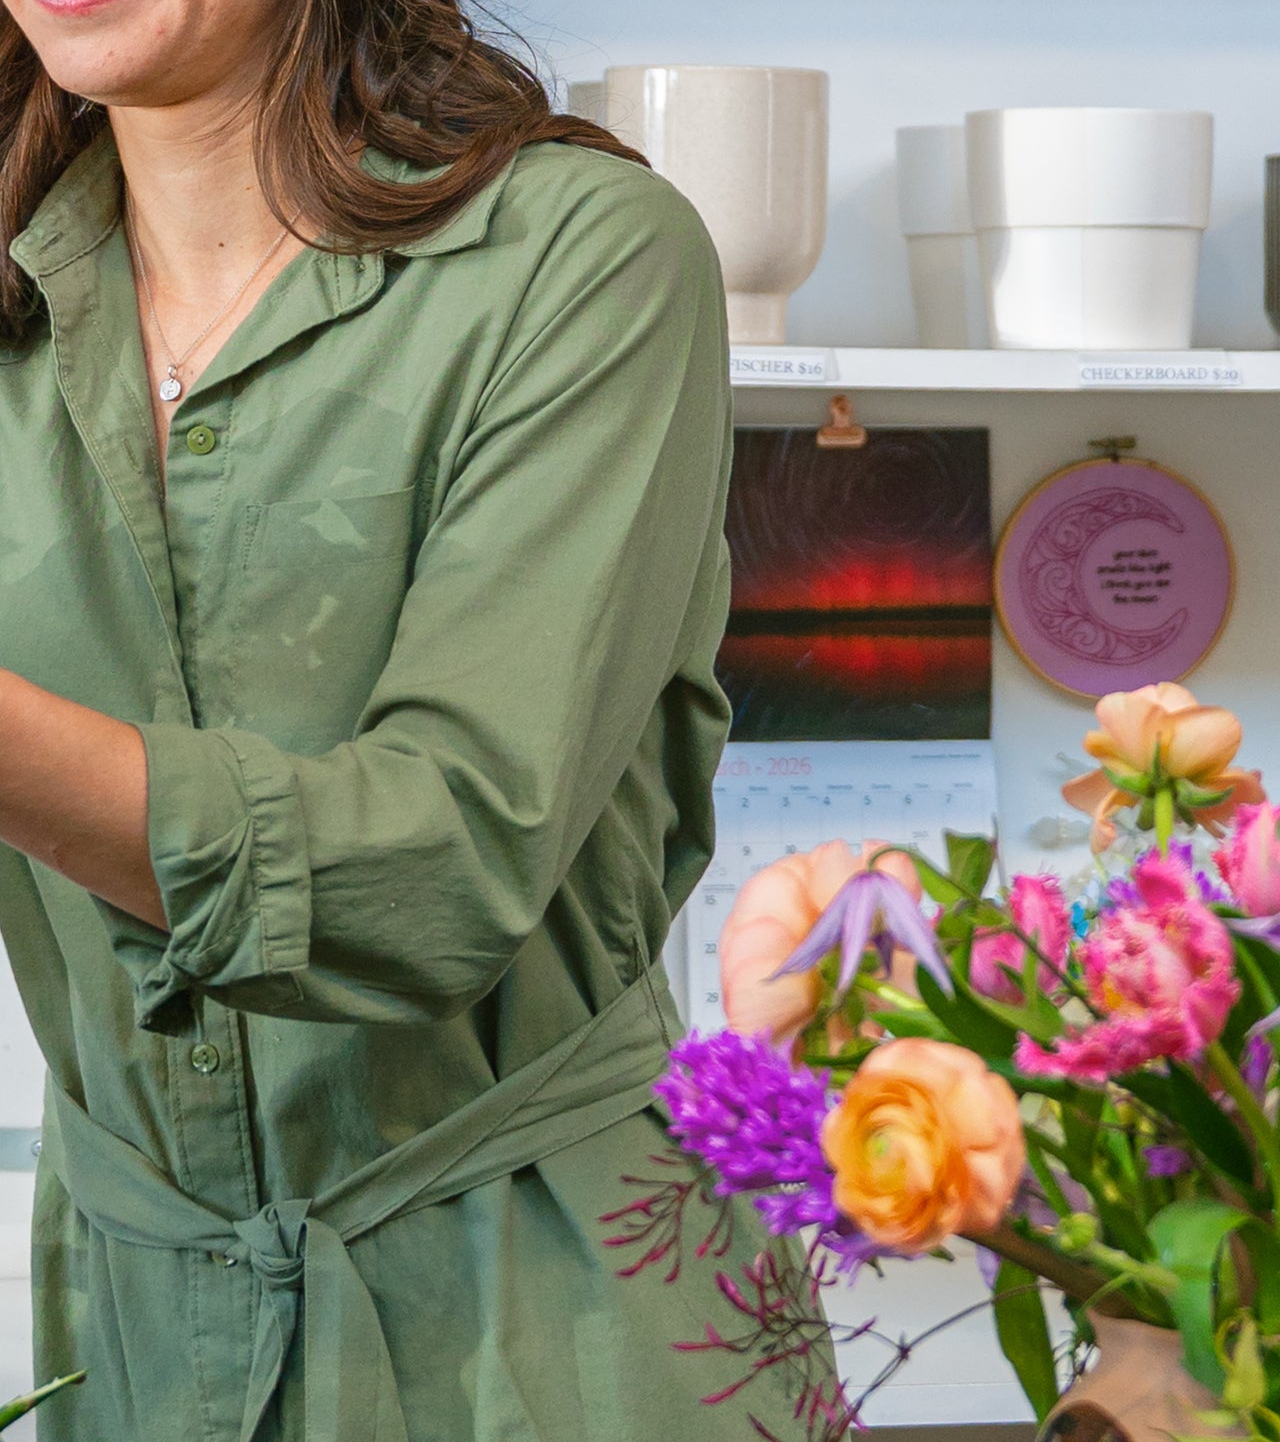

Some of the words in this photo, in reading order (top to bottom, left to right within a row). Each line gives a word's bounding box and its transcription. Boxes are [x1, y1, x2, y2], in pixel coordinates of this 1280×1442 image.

[798, 361, 823, 374] $16
[1081, 367, 1208, 380] CHECKERBOARD
[1213, 368, 1238, 380] $20
[768, 757, 812, 776] 2026
